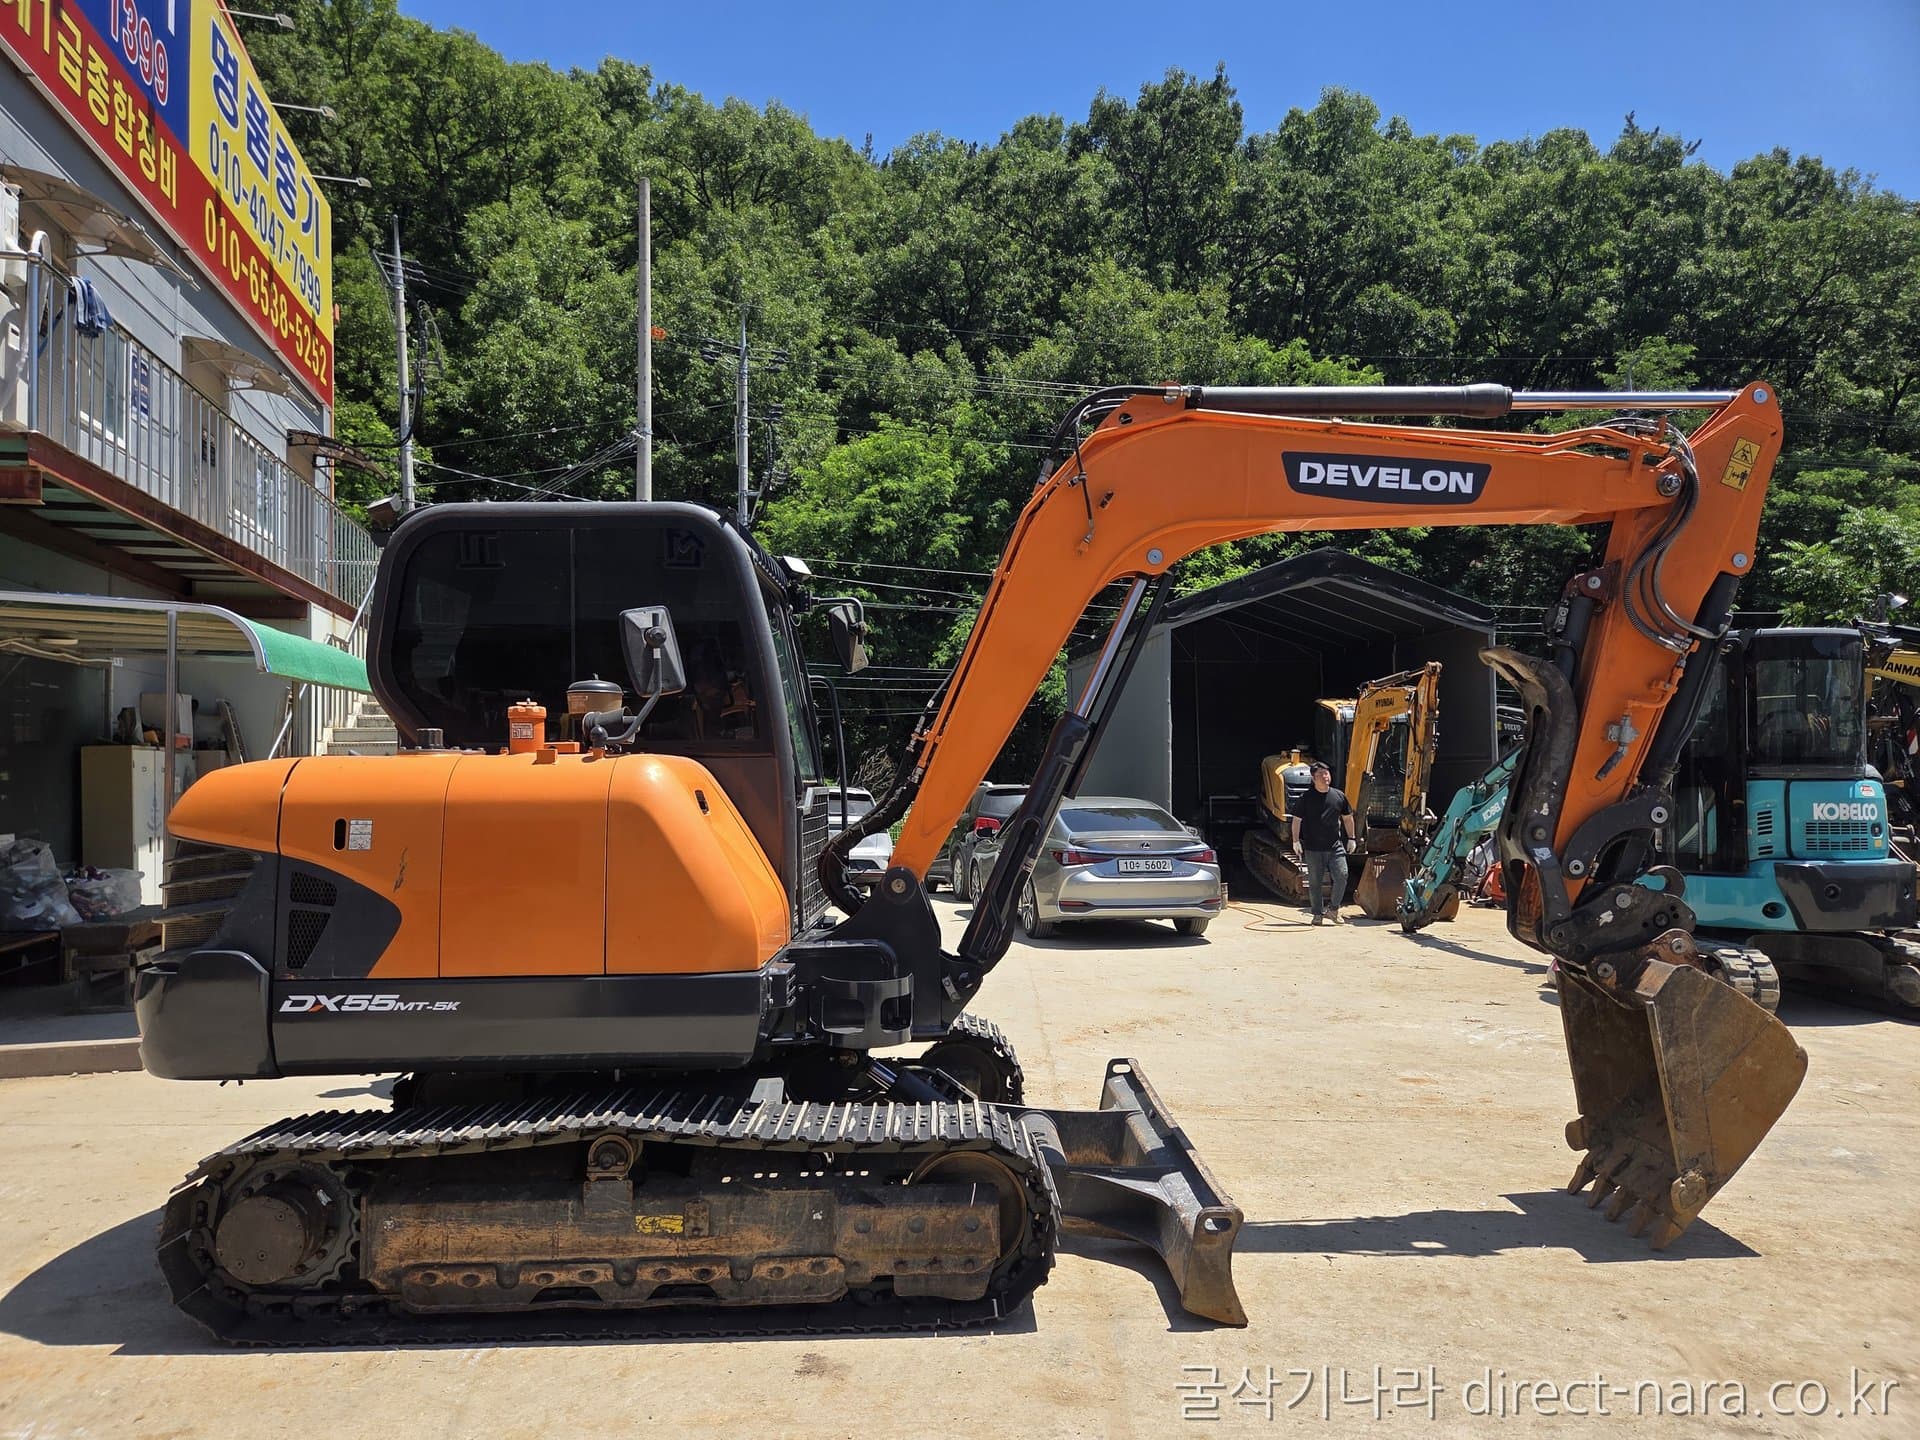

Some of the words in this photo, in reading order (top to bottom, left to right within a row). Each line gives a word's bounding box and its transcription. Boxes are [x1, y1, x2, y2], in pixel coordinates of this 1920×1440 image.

[211, 16, 321, 261] 명품중기
[209, 121, 322, 317] 010-4047-7999
[204, 197, 328, 387] 010-6538-5252
[1298, 461, 1475, 495] DEVELON
[1145, 860, 1168, 871] 5602
[1812, 802, 1878, 821] KOBELCO
